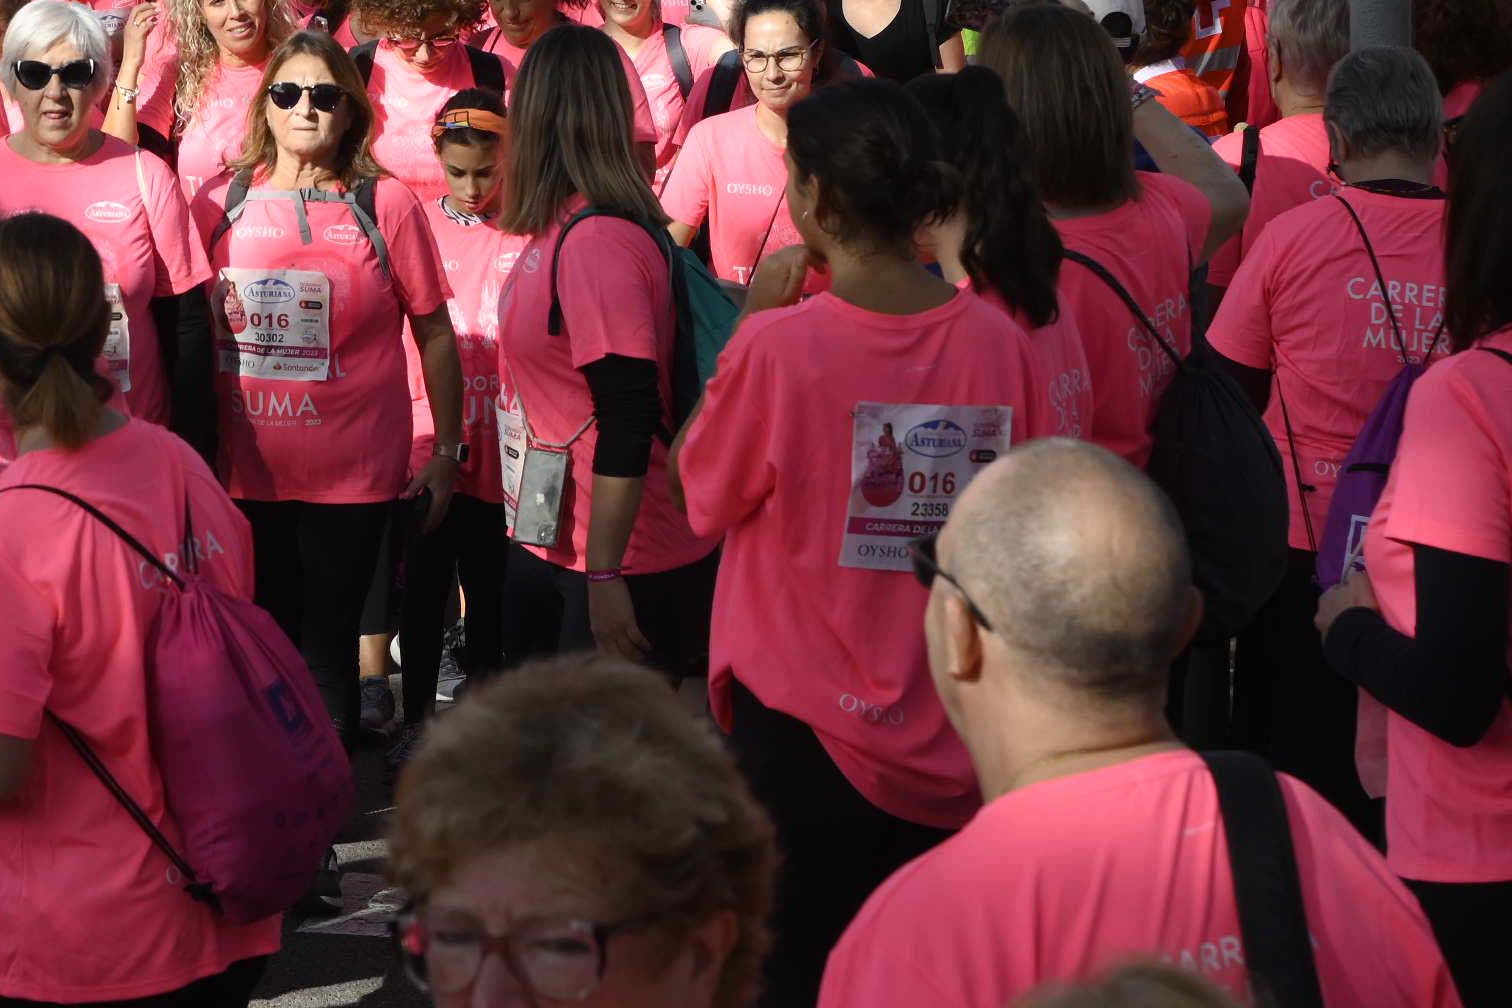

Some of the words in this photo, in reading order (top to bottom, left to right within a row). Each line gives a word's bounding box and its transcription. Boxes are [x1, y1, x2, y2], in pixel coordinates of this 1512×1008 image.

[727, 183, 773, 196] OYSHO
[89, 206, 130, 220] ASTURIANA
[237, 225, 286, 241] OYSHO
[250, 313, 290, 329] 016
[1371, 303, 1403, 327] DE
[1414, 308, 1447, 332] LA
[254, 332, 285, 343] 30302
[1362, 328, 1451, 353] MUJER
[282, 362, 320, 372] Santander
[232, 391, 319, 417] SUMA
[908, 472, 957, 494] 016
[911, 502, 950, 517] 23358
[857, 544, 910, 560] OYSHO
